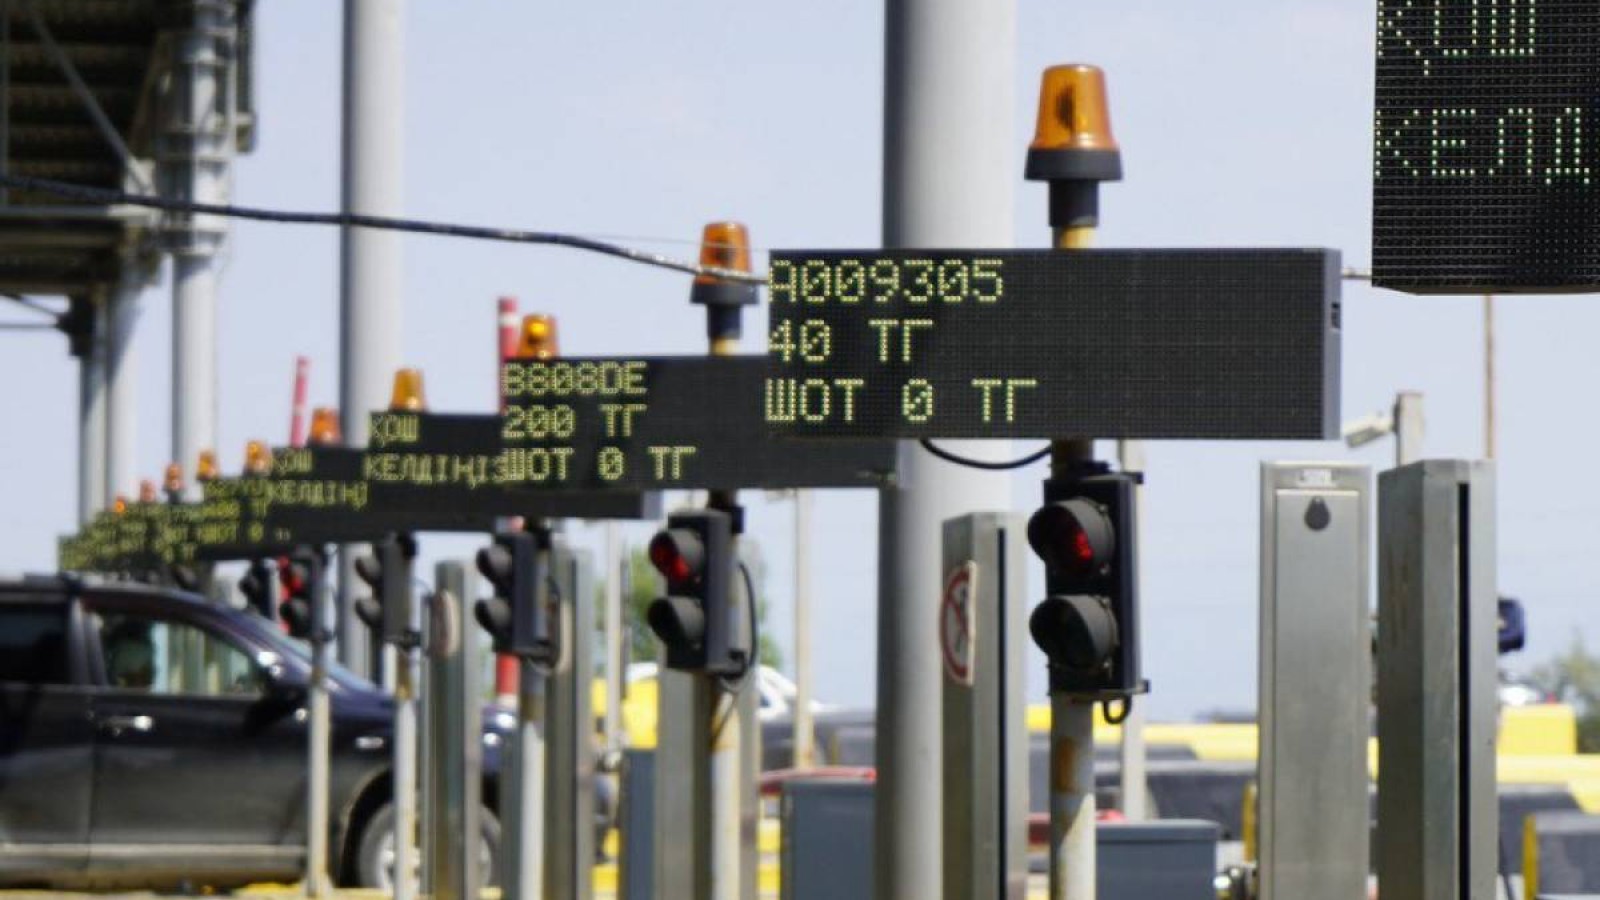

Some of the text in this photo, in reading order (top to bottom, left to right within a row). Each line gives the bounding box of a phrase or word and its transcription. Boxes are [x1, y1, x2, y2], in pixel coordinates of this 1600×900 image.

[1377, 0, 1536, 76] ҚОШ
[1375, 107, 1591, 185] КЕЛД
[769, 259, 1003, 302] A009305
[769, 319, 933, 362] 40 ТГ
[501, 403, 648, 439] 200 ТГ
[764, 378, 1037, 423] ШОТ 0 ТГ
[599, 446, 624, 481] 0
[648, 446, 697, 481] ТГ
